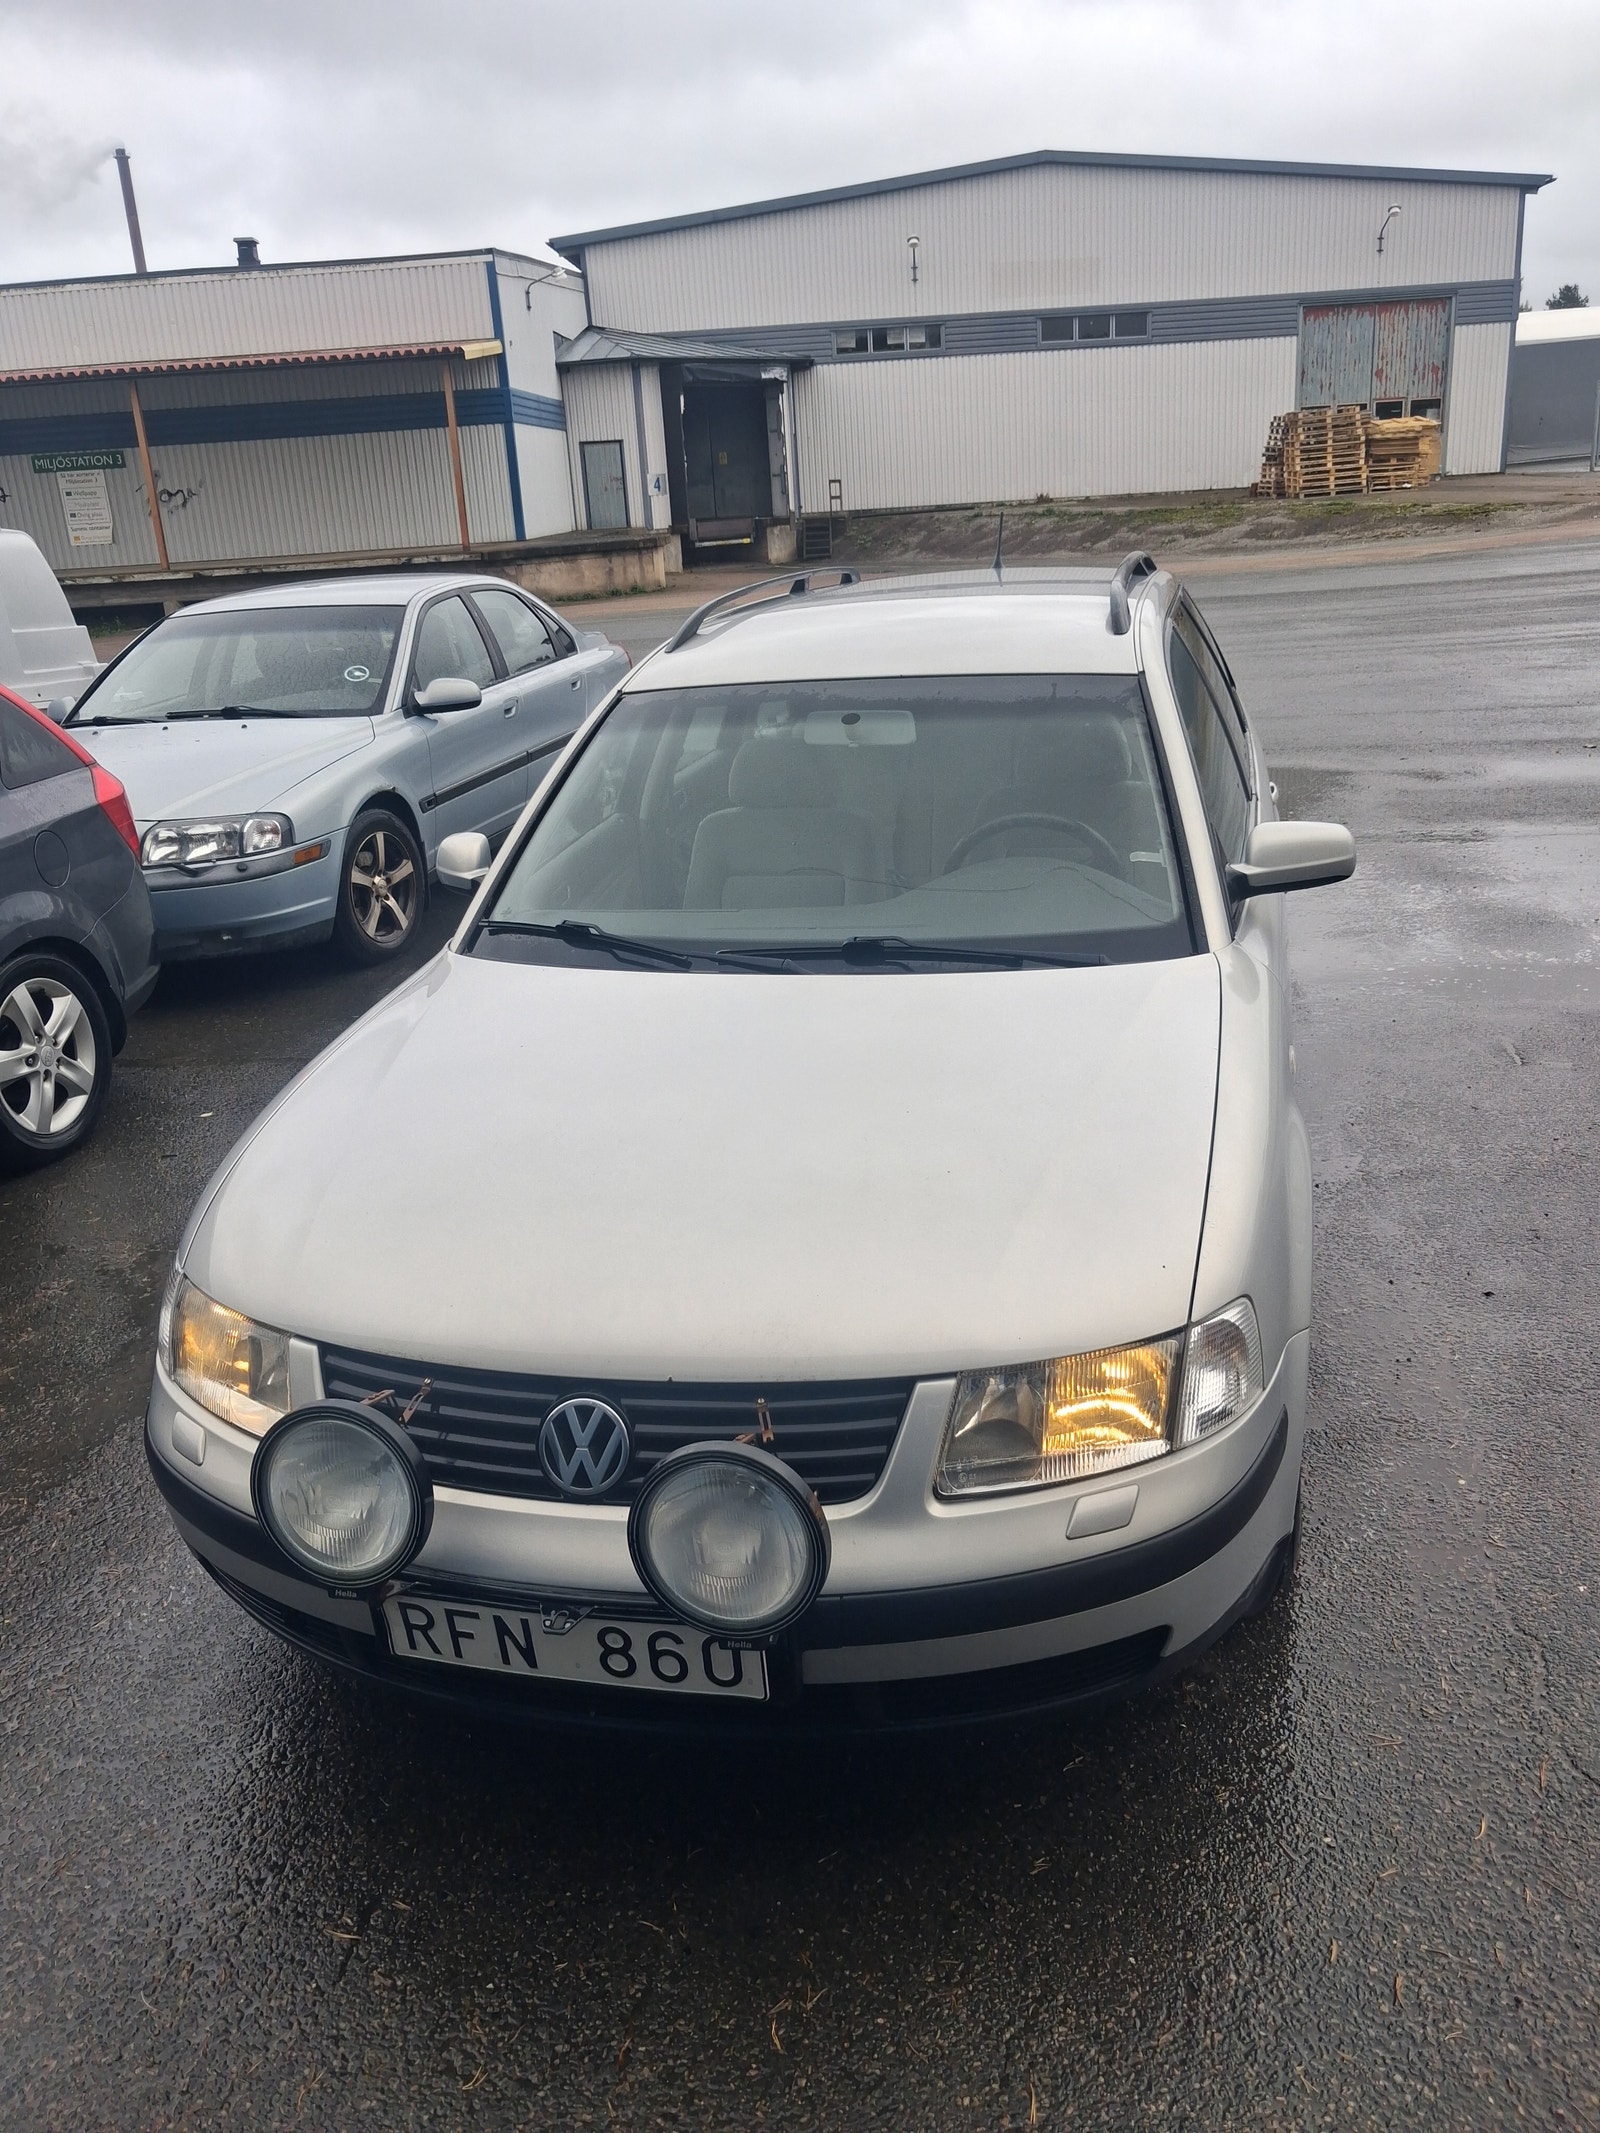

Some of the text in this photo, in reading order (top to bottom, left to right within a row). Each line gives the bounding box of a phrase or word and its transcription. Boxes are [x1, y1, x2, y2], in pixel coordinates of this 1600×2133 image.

[34, 454, 122, 471] MILJÖSTATION 3
[653, 477, 661, 492] 4
[541, 1399, 628, 1493] VW
[335, 1589, 357, 1598] Hella
[397, 1601, 743, 1688] RFN 860
[727, 1640, 752, 1648] Hella
